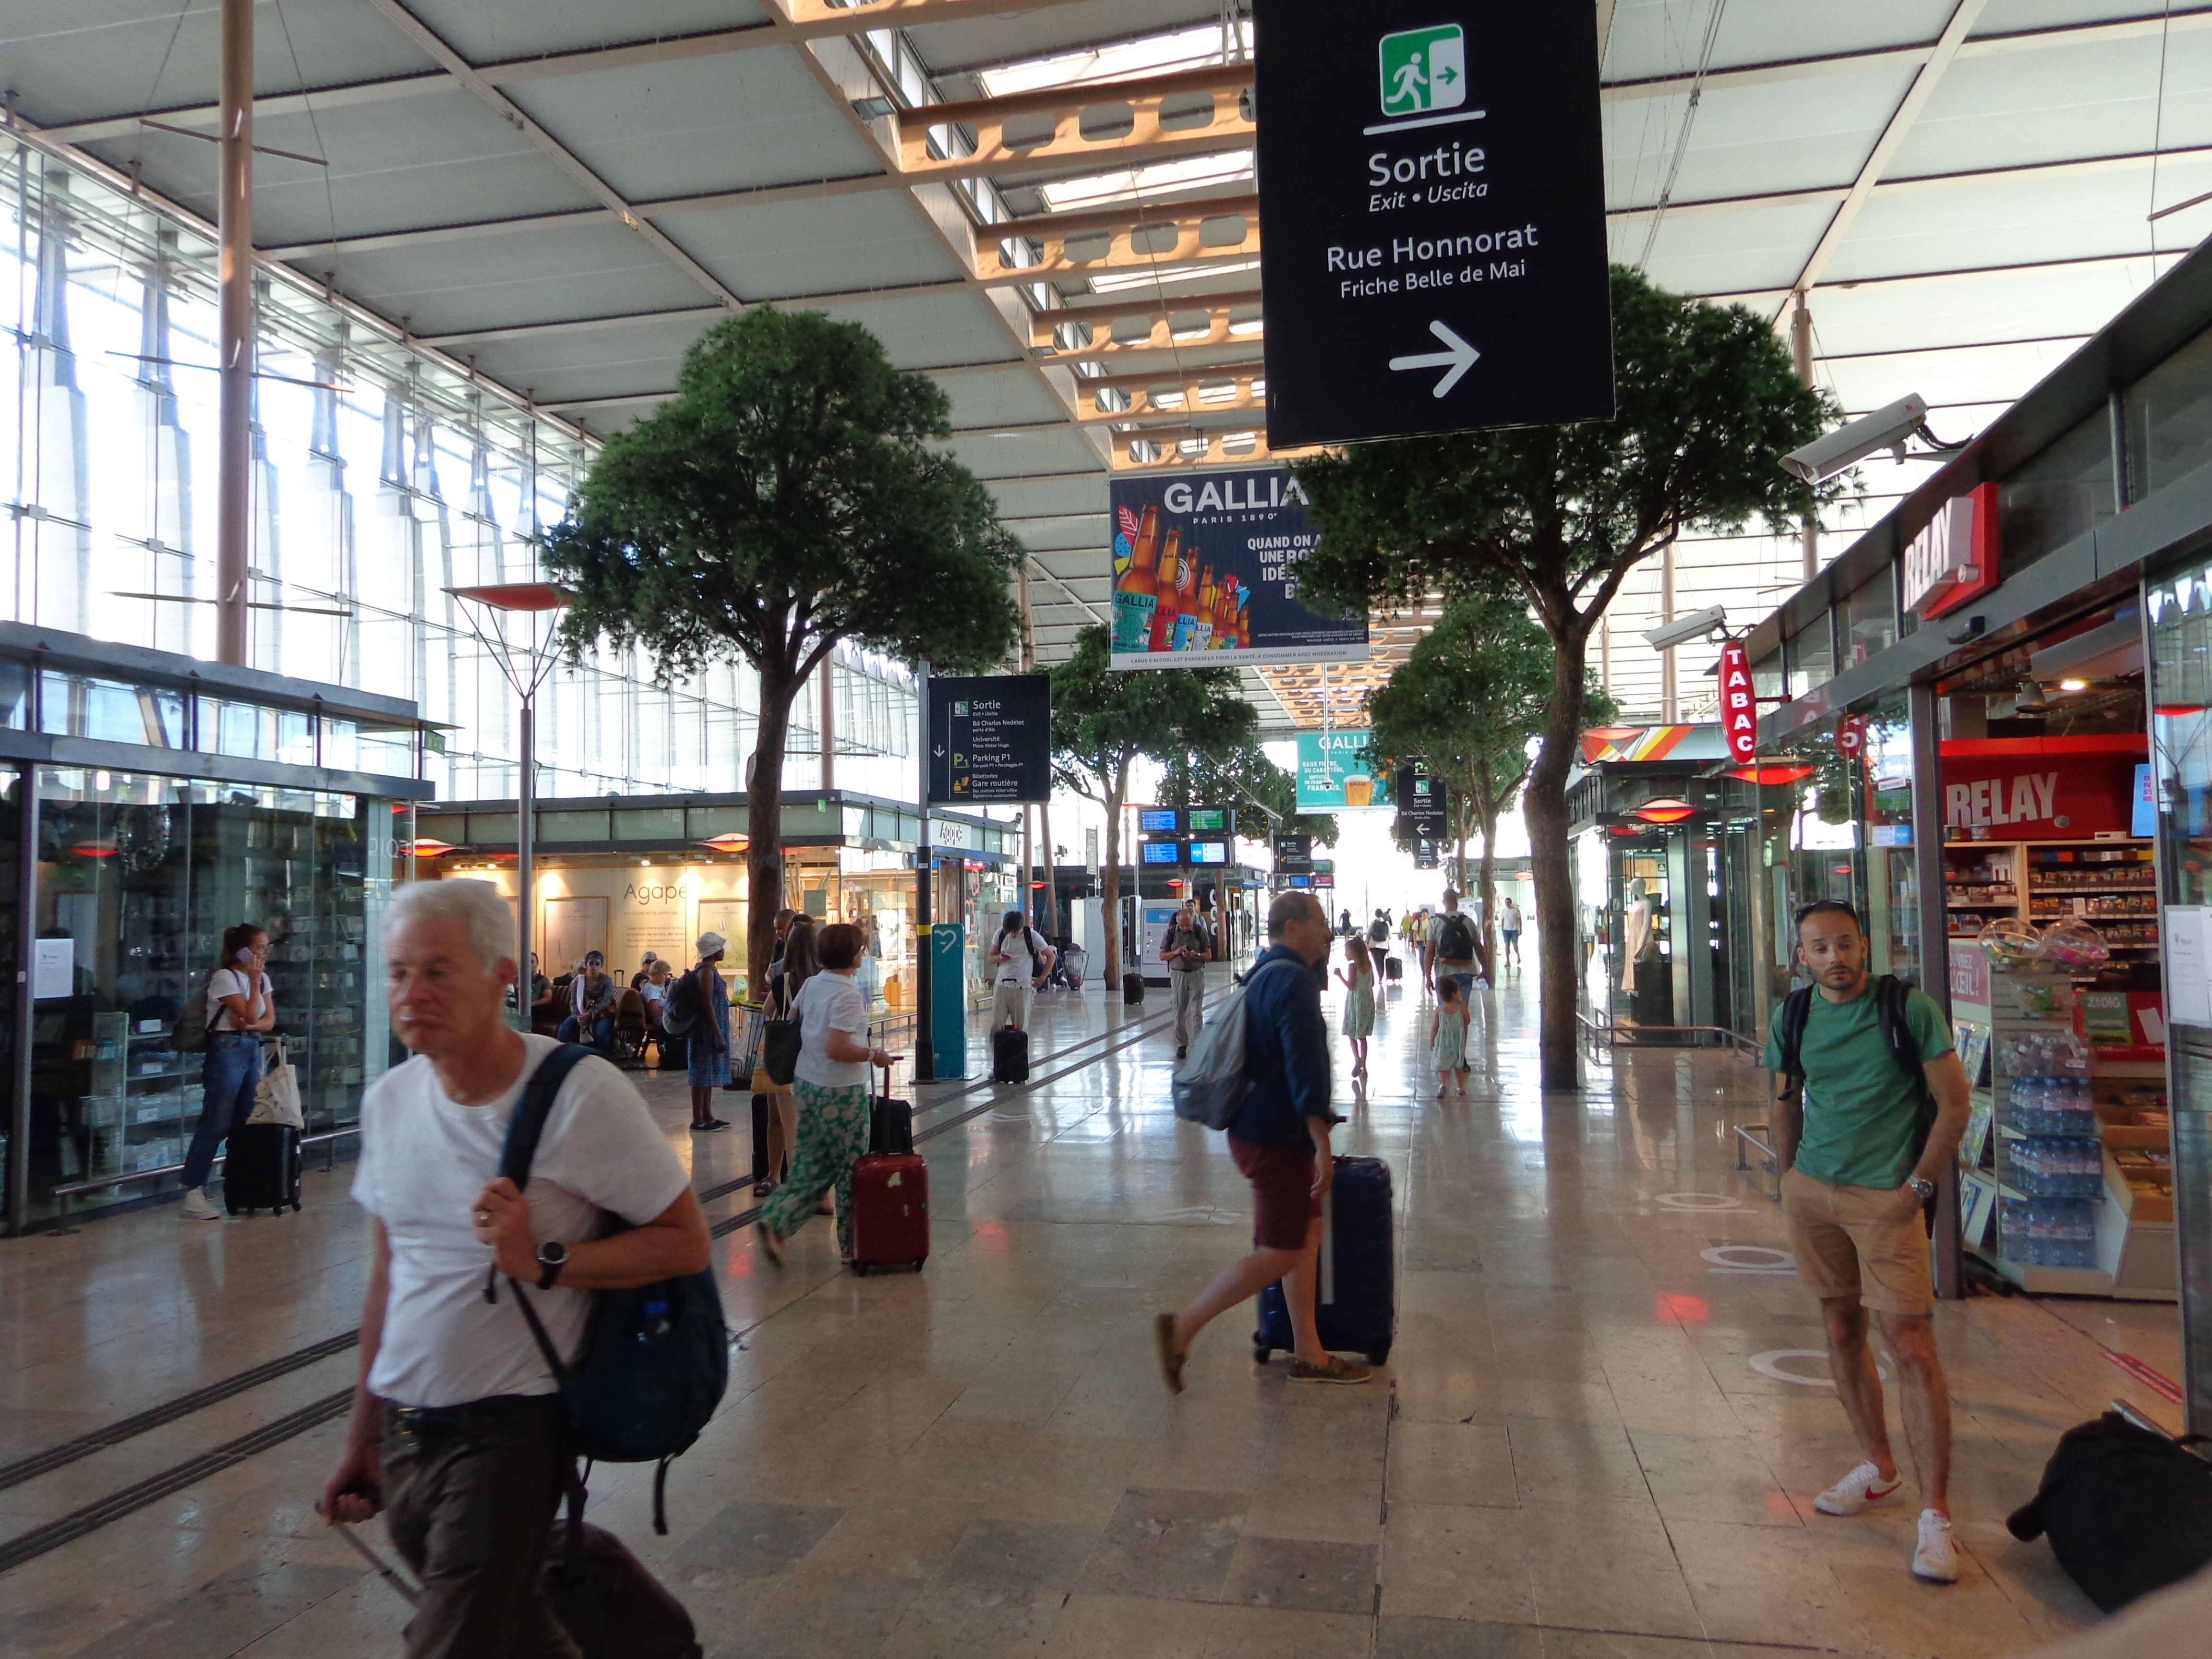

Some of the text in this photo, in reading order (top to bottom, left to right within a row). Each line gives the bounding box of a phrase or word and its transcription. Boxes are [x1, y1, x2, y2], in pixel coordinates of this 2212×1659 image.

[1368, 142, 1486, 187] Sortie
[1369, 181, 1488, 213] Exit Uscita
[1327, 223, 1539, 273] Rue Honnorat
[1340, 259, 1527, 299] Friche Belle de Mai
[1164, 476, 1310, 514] GALLIA
[1192, 515, 1233, 525] PARIS
[1247, 536, 1290, 551] QUAND
[1293, 534, 1311, 547] ON
[1259, 550, 1285, 564] UNE
[1903, 497, 1953, 614] RELAY
[1115, 593, 1154, 608] GALLIA
[973, 700, 1001, 709] Sortie
[1727, 649, 1754, 752] TABAC
[973, 754, 1000, 762] Parking
[1947, 771, 2057, 829] RELAY
